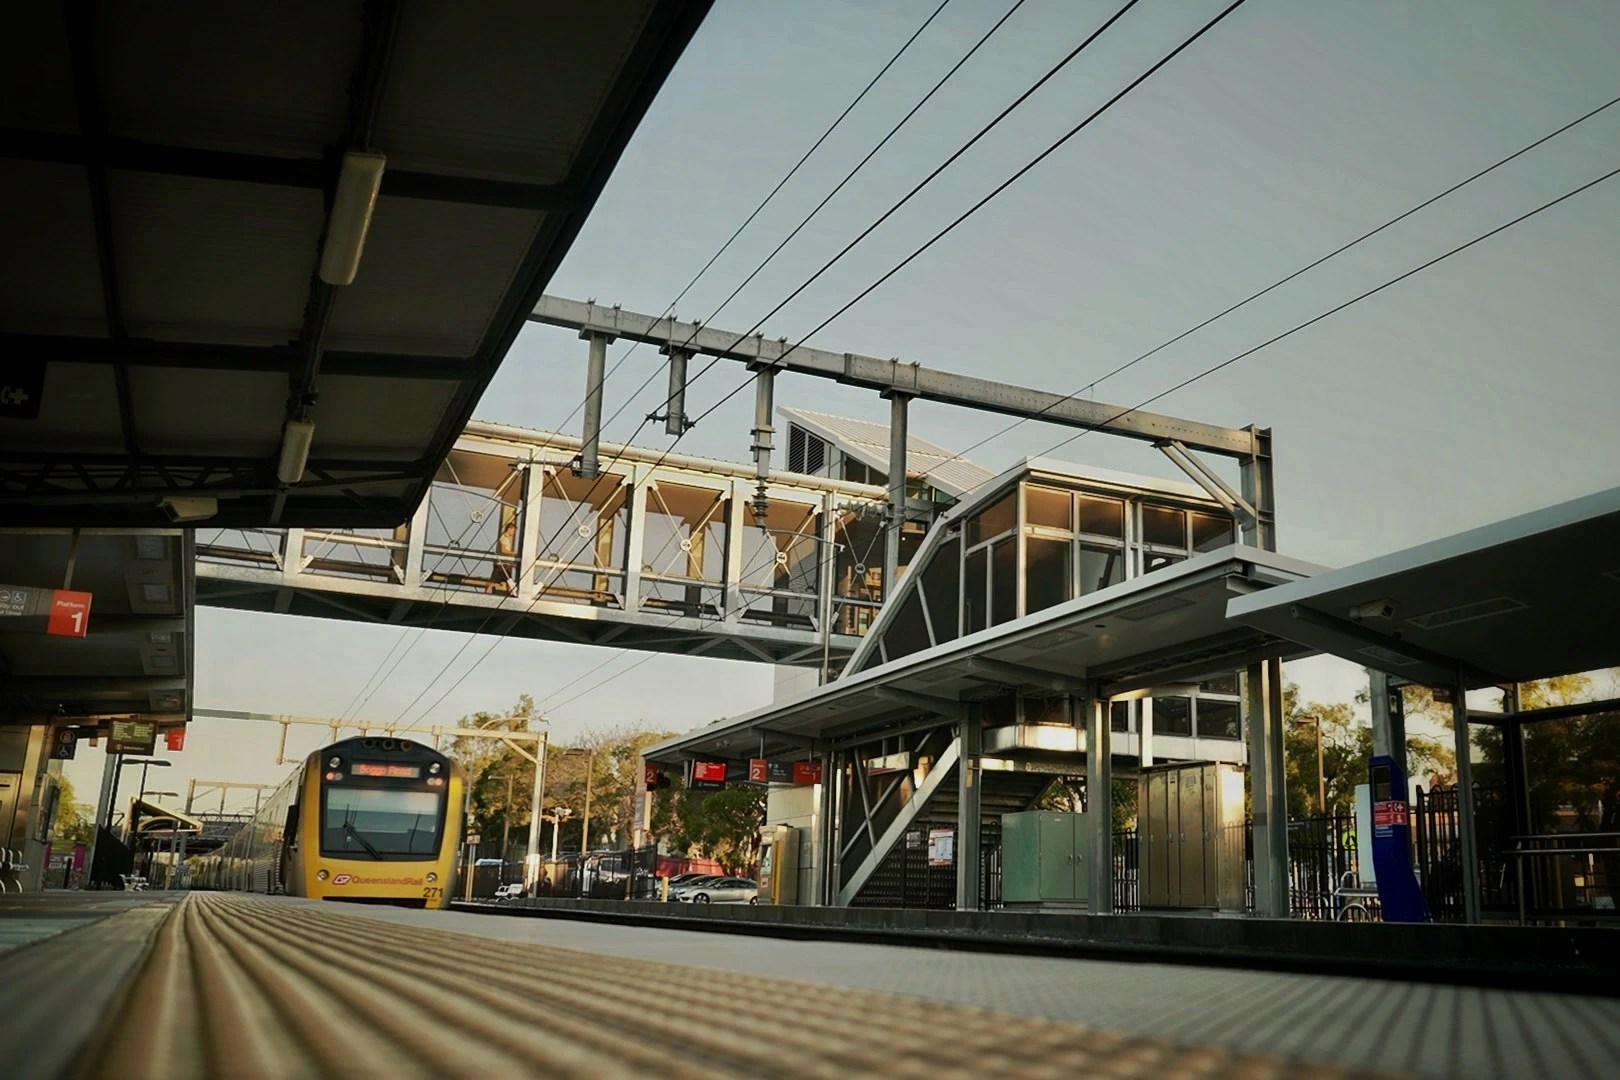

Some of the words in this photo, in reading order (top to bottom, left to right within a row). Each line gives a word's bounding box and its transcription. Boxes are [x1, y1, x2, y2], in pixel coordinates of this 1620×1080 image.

[71, 611, 83, 633] 1
[646, 771, 655, 783] 2
[752, 768, 761, 780] 2
[423, 886, 444, 898] 271
